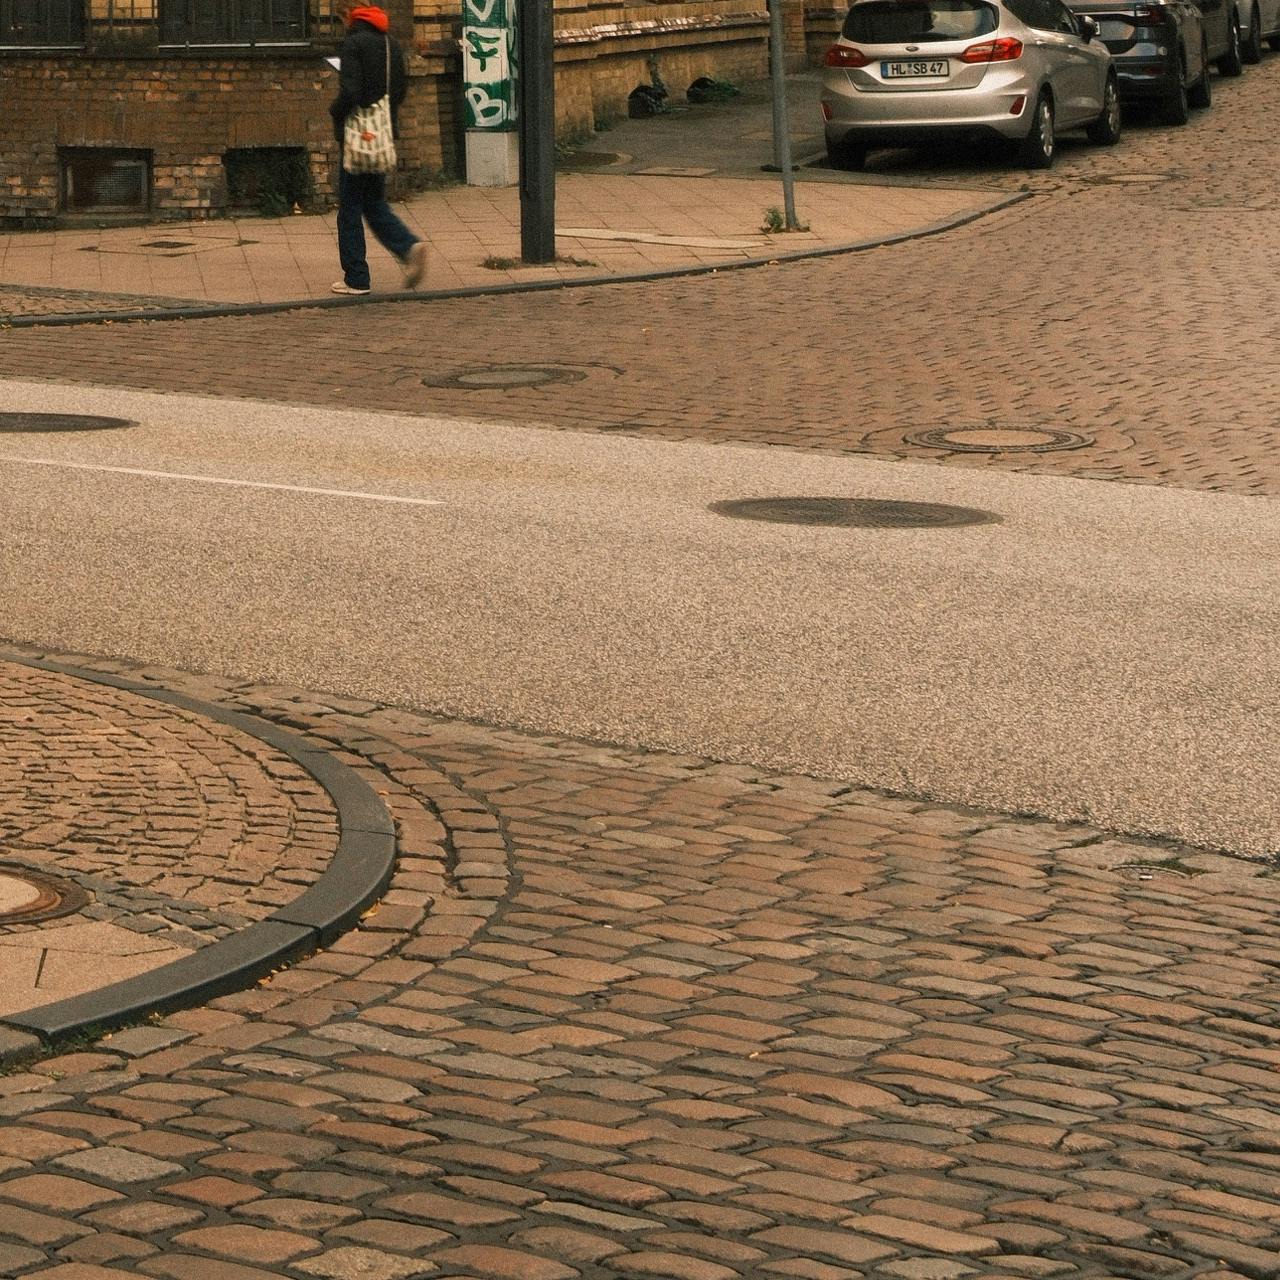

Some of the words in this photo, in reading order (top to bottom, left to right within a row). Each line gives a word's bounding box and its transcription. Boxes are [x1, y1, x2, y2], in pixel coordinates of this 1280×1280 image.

[891, 64, 906, 75] HL
[913, 62, 928, 74] SB
[929, 62, 943, 73] 47
